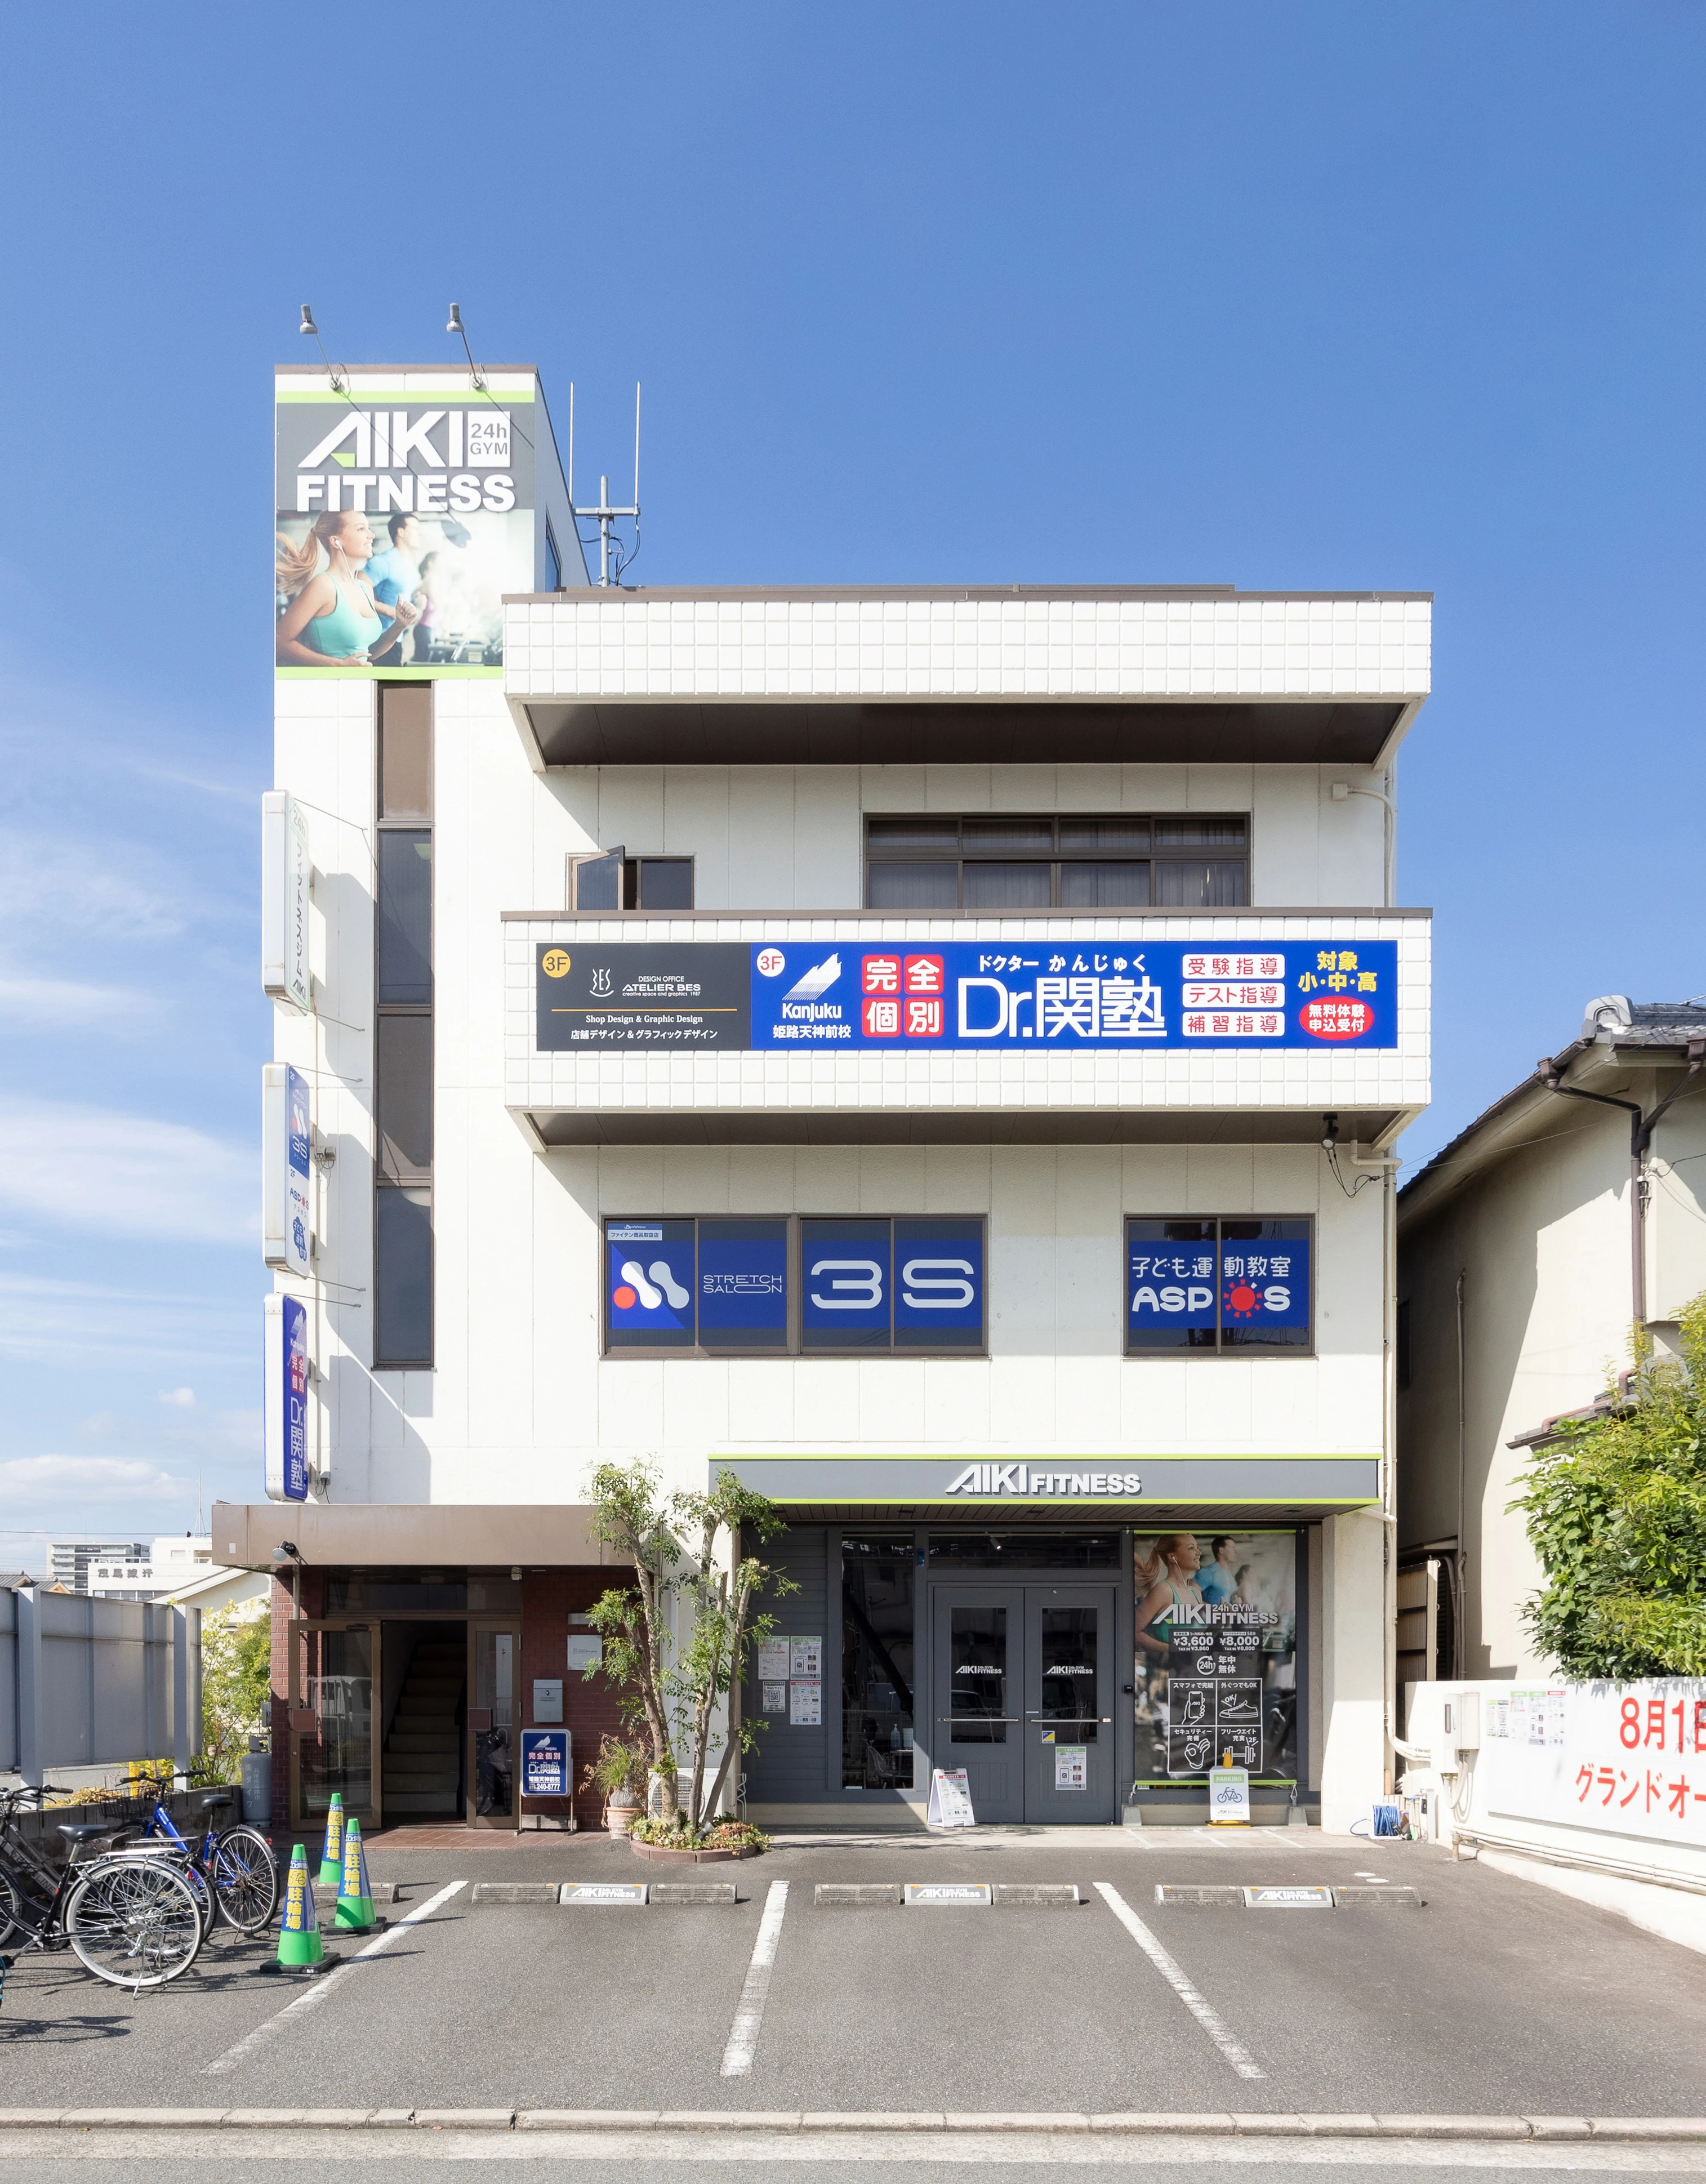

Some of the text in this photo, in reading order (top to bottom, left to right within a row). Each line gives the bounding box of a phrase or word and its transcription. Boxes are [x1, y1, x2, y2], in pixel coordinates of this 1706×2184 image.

[470, 423, 507, 439] 24h
[297, 411, 463, 468] AIKI
[470, 443, 507, 455] GYM
[297, 474, 515, 512] FITNESS
[545, 956, 568, 972] 3F
[760, 956, 782, 970] 3F
[979, 954, 1146, 972] ドクター かんじゅく
[1188, 957, 1278, 976] 受験指導
[1317, 950, 1358, 971] 対象
[866, 958, 940, 991] 完全
[1298, 971, 1377, 993] 小・中・高
[1189, 986, 1278, 1004] テスト指導
[957, 975, 1168, 1038] Dr.関塾
[1308, 1003, 1365, 1018] 無料体験
[586, 1015, 703, 1025] Shop Design & Graphic Design
[866, 1001, 940, 1033] 個別
[1187, 1015, 1278, 1033] 補習指導
[773, 1024, 852, 1039] 姫路天神前校
[1308, 1018, 1365, 1033] 申込受付
[571, 1029, 718, 1040] 店舗デザイン & グラフィックデザイン
[292, 1135, 308, 1159] 3S
[1132, 1256, 1291, 1278] 子ども運動教室
[703, 1275, 782, 1284] STRETCH
[945, 1464, 1142, 1494] AIKI FITNESS
[1152, 1604, 1211, 1625] AIKI
[1212, 1612, 1279, 1625] FITNESS
[1173, 1636, 1214, 1647] ¥3,600
[1219, 1636, 1260, 1647] ¥8,000
[1200, 1661, 1213, 1669] 24h
[1218, 1655, 1236, 1664] 年中
[955, 1666, 977, 1674] AIKI
[1046, 1666, 1068, 1674] AIKI
[1218, 1665, 1236, 1674] 無休
[1224, 1694, 1235, 1703] OK
[528, 1764, 561, 1774] Dr.関塾
[326, 1825, 341, 1860] 駐輪場
[344, 1854, 360, 1897] 駐輪場
[570, 1887, 602, 1897] AIKI
[915, 1888, 946, 1898] AIKI
[1257, 1891, 1287, 1901] AIKI
[286, 1887, 303, 1930] 駐輪場
